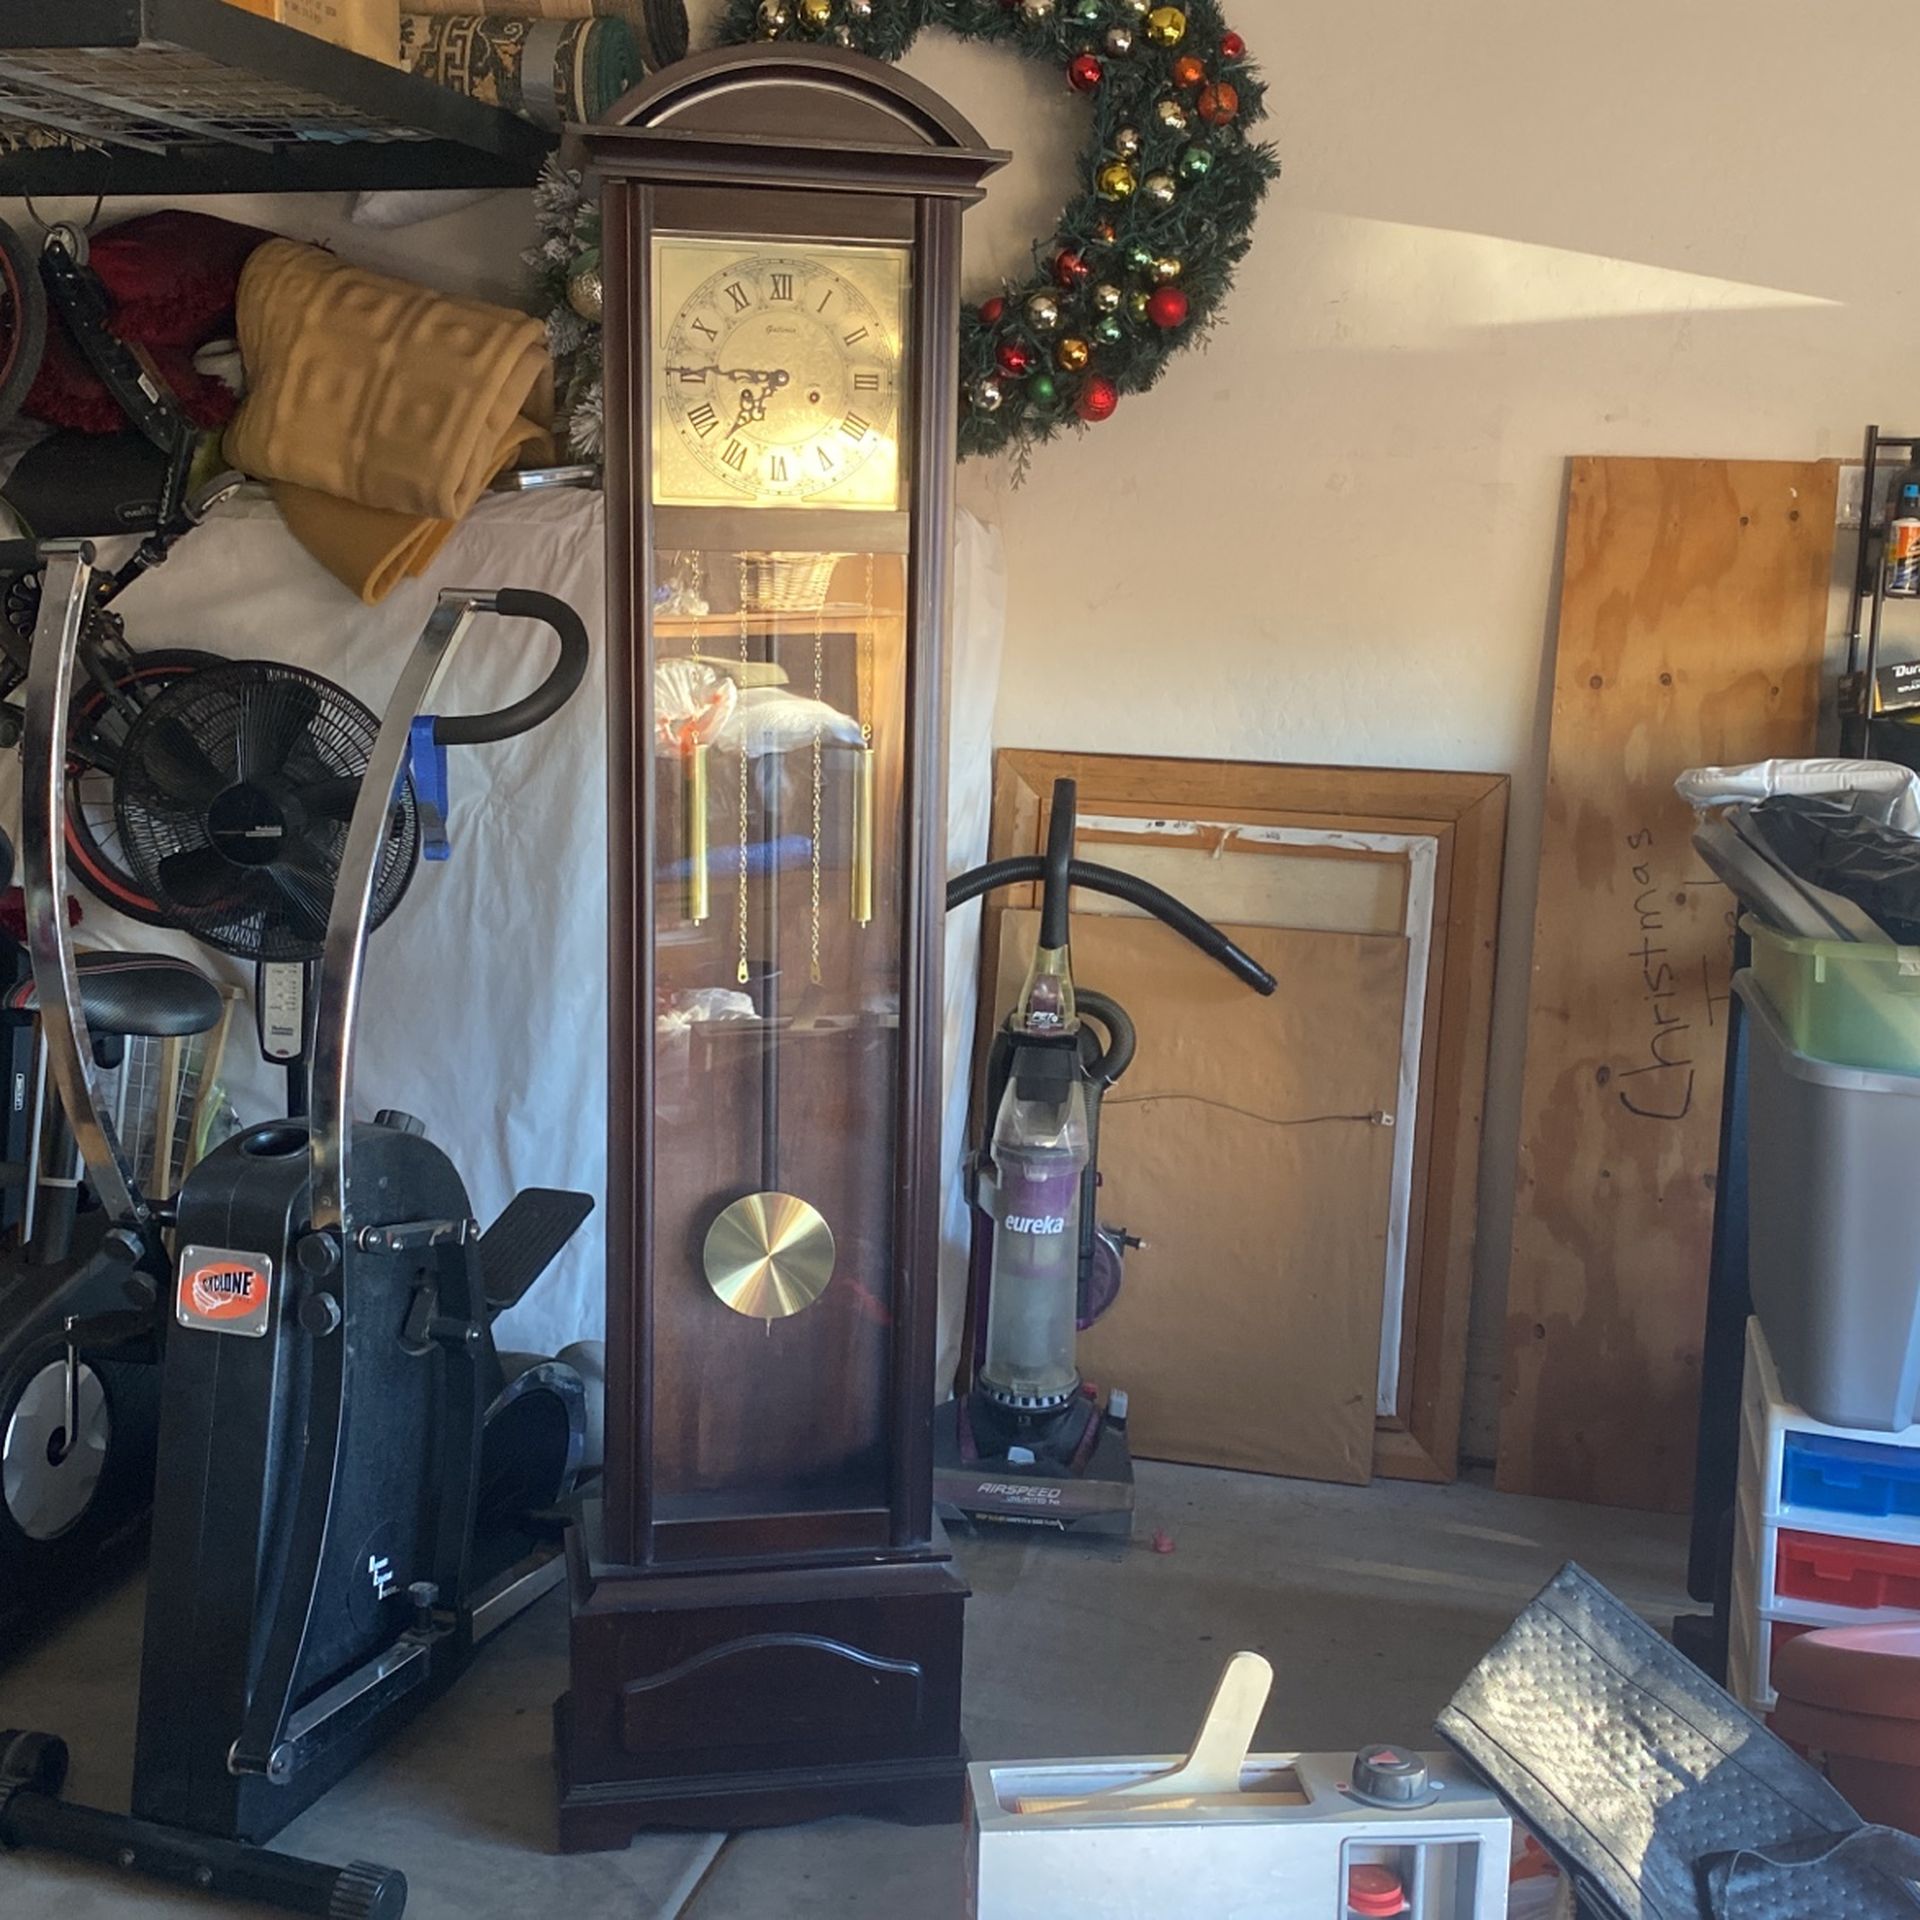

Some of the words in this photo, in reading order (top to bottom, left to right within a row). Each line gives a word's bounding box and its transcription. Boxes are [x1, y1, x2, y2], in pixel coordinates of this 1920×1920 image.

[724, 281, 751, 313] XI
[769, 273, 794, 301] XII
[690, 317, 718, 343] X
[843, 326, 870, 347] II
[853, 373, 879, 391] III
[687, 402, 719, 439] VIII
[721, 438, 748, 472] VII
[770, 455, 788, 481] VI
[1618, 827, 1695, 1119] Christmas
[1005, 1214, 1064, 1234] eureka
[203, 1271, 254, 1296] CYCLONE
[977, 1482, 1061, 1498] AIRSPEED
